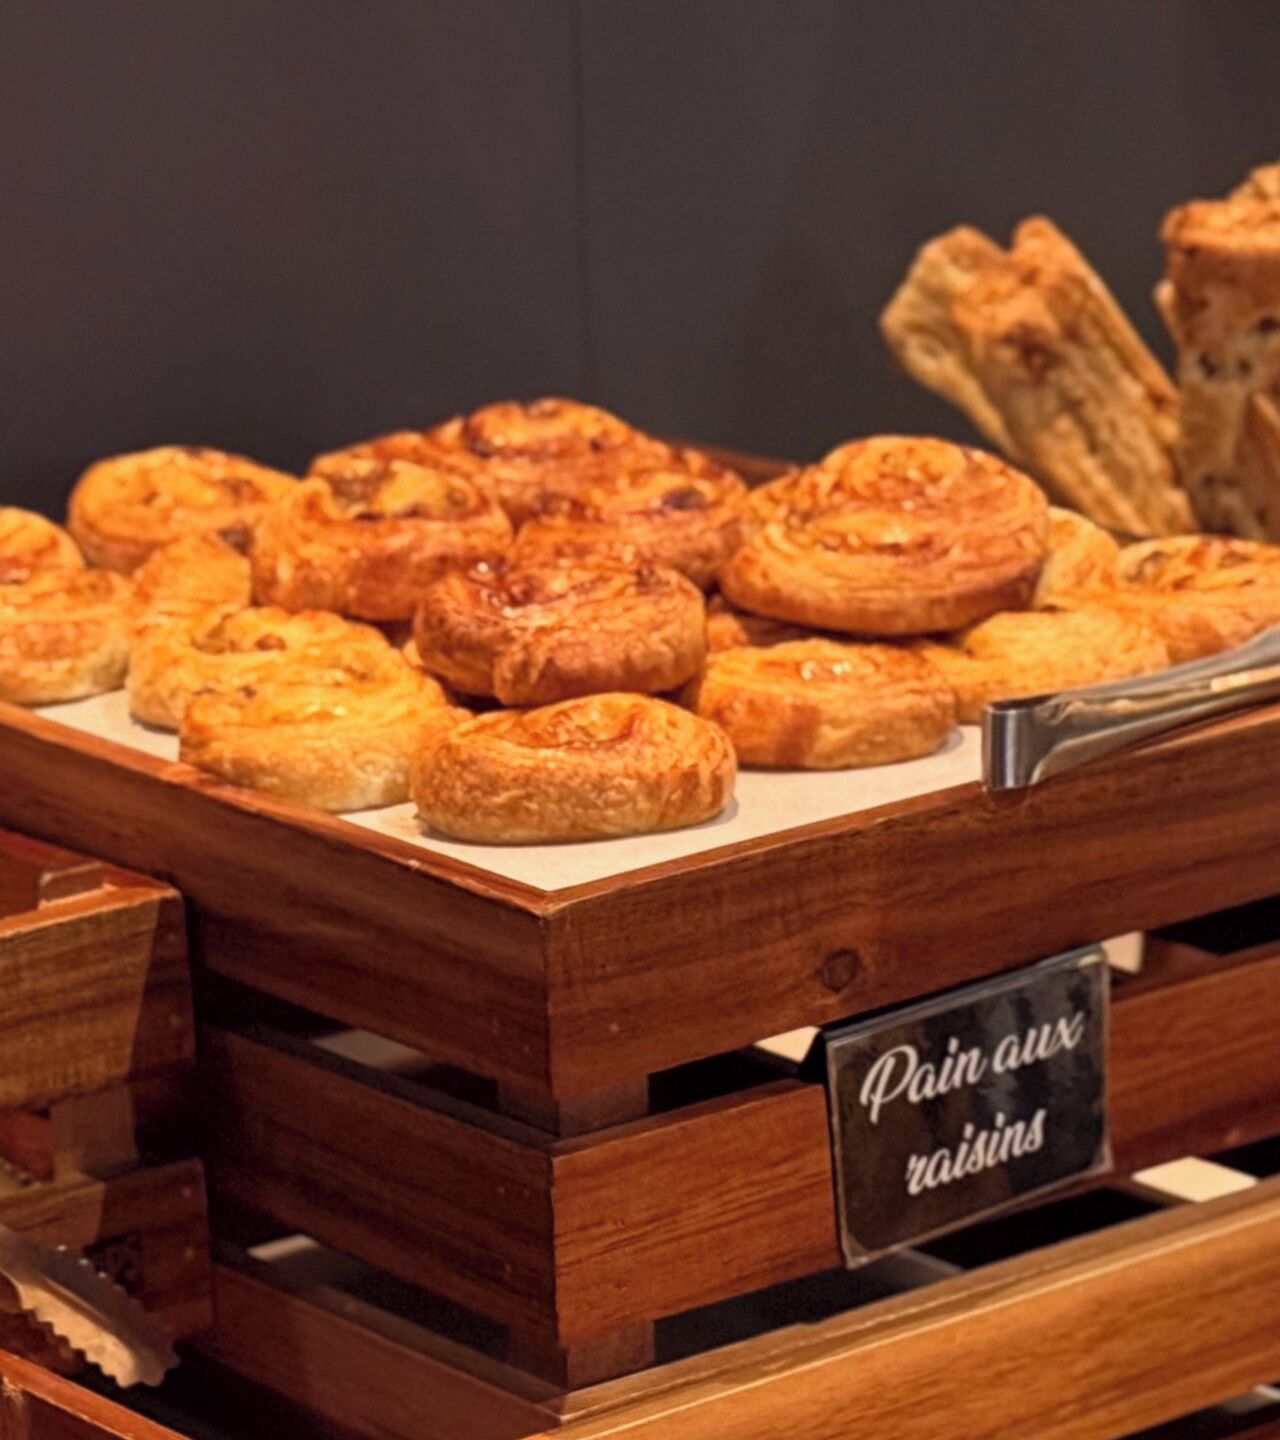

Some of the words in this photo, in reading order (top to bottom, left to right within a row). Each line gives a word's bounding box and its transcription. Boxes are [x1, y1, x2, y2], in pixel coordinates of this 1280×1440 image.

[859, 1037, 988, 1124] Pain
[992, 1011, 1086, 1074] aux
[905, 1108, 1048, 1196] raisins
